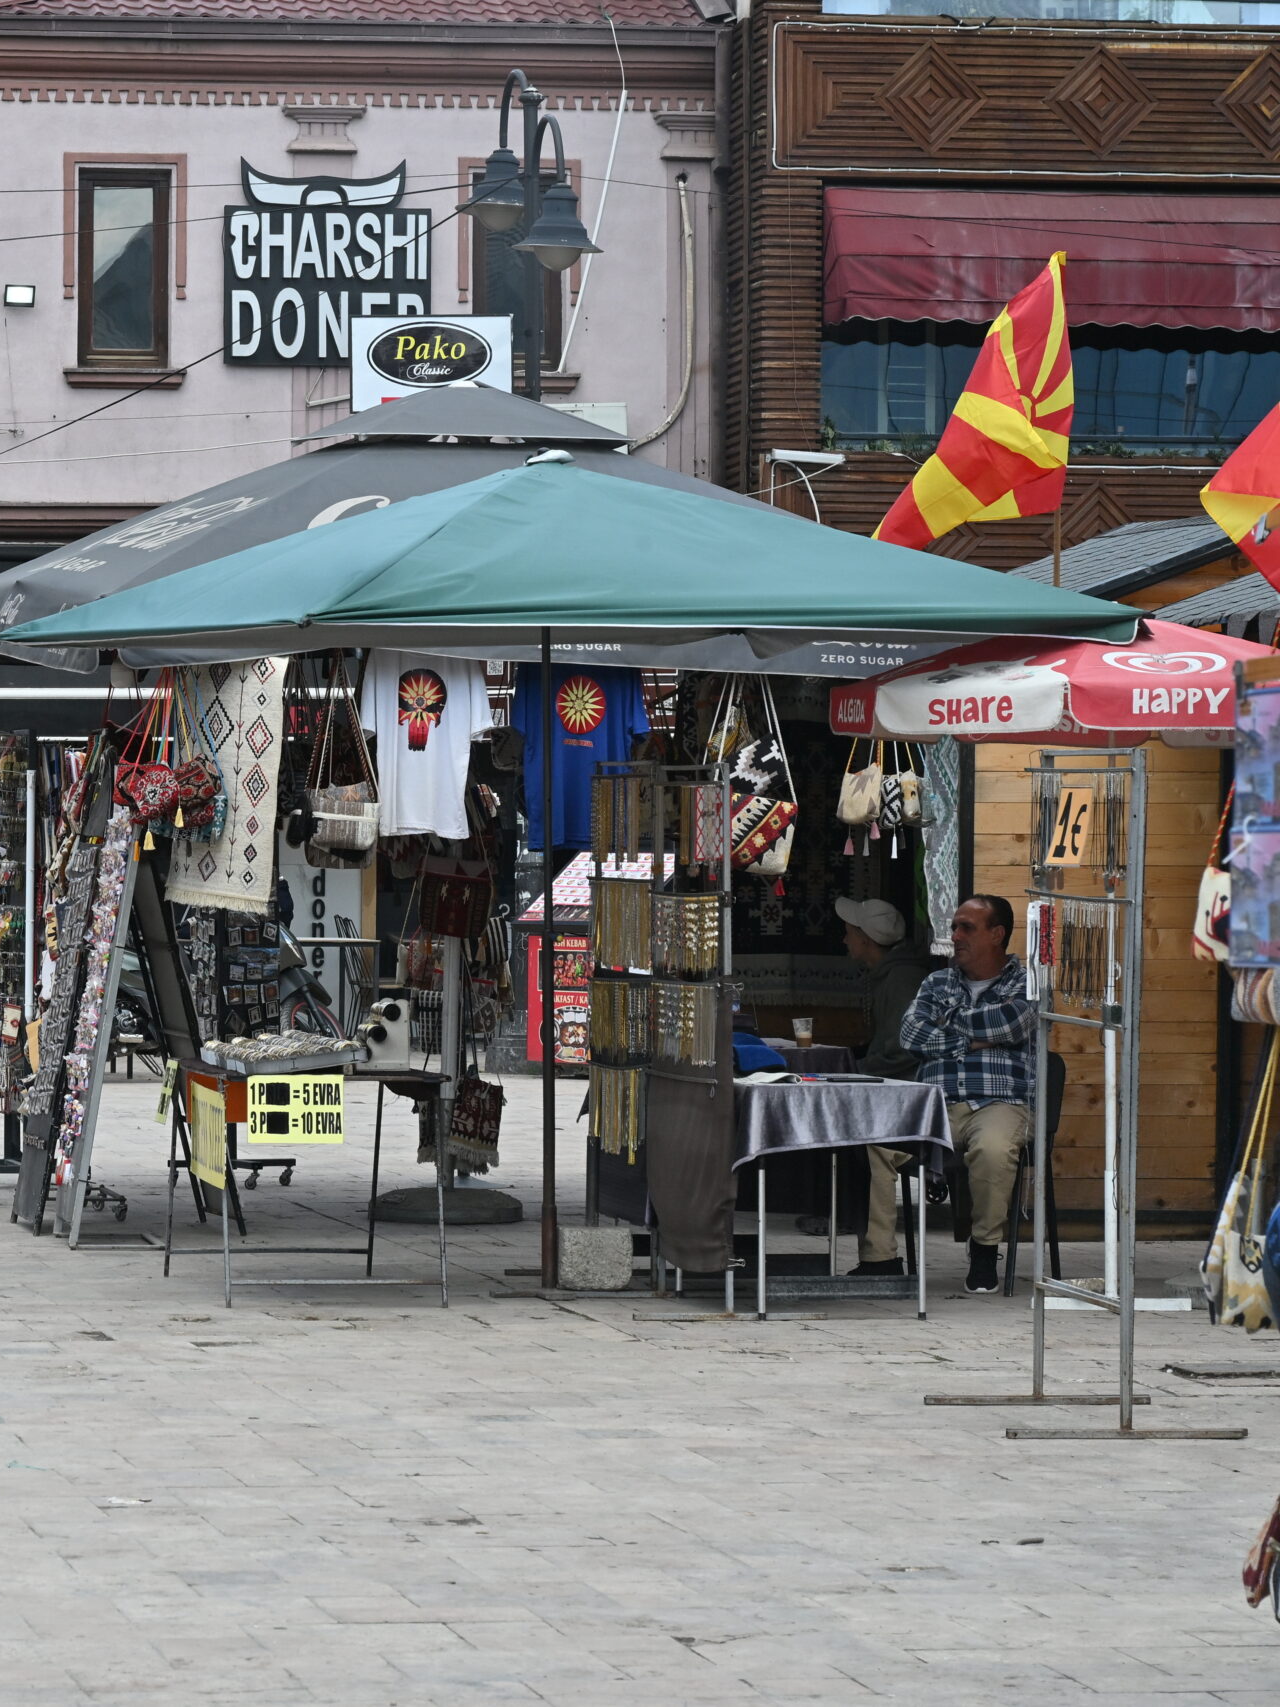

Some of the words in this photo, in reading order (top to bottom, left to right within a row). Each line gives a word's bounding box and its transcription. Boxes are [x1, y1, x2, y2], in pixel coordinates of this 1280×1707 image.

[229, 210, 428, 280] CHARSHI
[394, 335, 466, 360] Pako
[406, 362, 454, 380] Classic
[821, 654, 855, 665] ZERO
[859, 656, 904, 667] SUGAR
[566, 938, 587, 948] KEBAB
[250, 1083, 256, 1105] 1
[303, 1083, 310, 1106] 5
[313, 1083, 341, 1106] EVRA
[250, 1112, 257, 1134] 3
[301, 1111, 313, 1134] 10
[315, 1111, 342, 1134] EVRA
